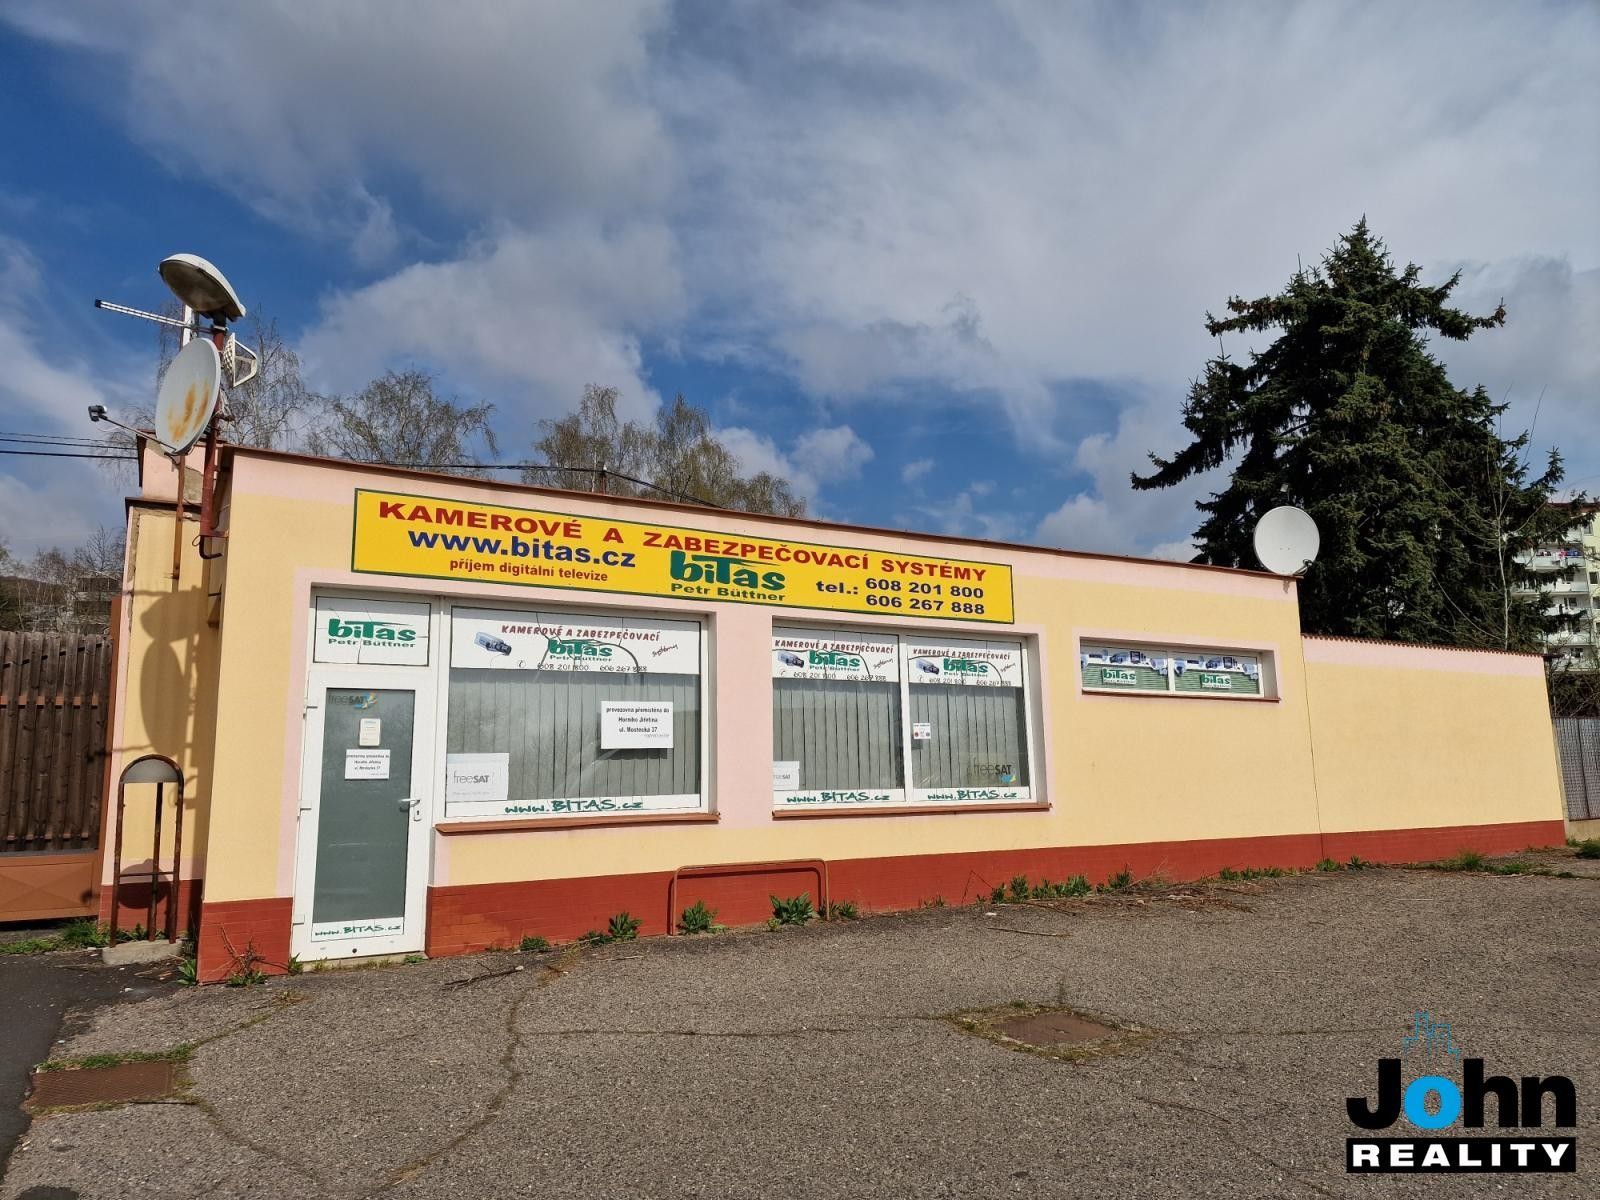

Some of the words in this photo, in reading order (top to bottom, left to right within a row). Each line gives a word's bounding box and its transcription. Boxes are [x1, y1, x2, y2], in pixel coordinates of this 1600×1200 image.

[379, 501, 582, 538] KAMEROVÉ
[603, 528, 624, 543] A
[643, 532, 868, 569] ZABEZPEČOVACÍ
[881, 560, 986, 582] SYSTÉMY
[408, 531, 636, 567] www.bitas.cz
[450, 559, 495, 573] příjem
[499, 562, 554, 577] digitální
[559, 568, 608, 581] televize
[671, 583, 711, 596] Petr
[717, 586, 785, 601] Büttner
[816, 580, 859, 594] tel.:
[866, 578, 901, 592] 608
[909, 582, 942, 595] 201
[950, 585, 983, 598] 800
[866, 594, 902, 608] 606
[909, 598, 943, 611] 267
[951, 601, 985, 615] 888
[501, 625, 562, 636] KAMEROVÉ
[576, 629, 661, 641] ZABEZPEČOVACÍ
[775, 639, 819, 649] KAMEROVÉ
[830, 643, 893, 653] ZABEZPEČOVACÍ
[913, 648, 949, 656] KAMEROVÉ
[454, 771, 489, 783] freeSAT
[787, 792, 890, 802] www.BITAS.cz
[928, 790, 1017, 800] www.BITAS.cz
[505, 799, 642, 814] www.BITAS.cz
[315, 925, 401, 936] www.BITAS.cz
